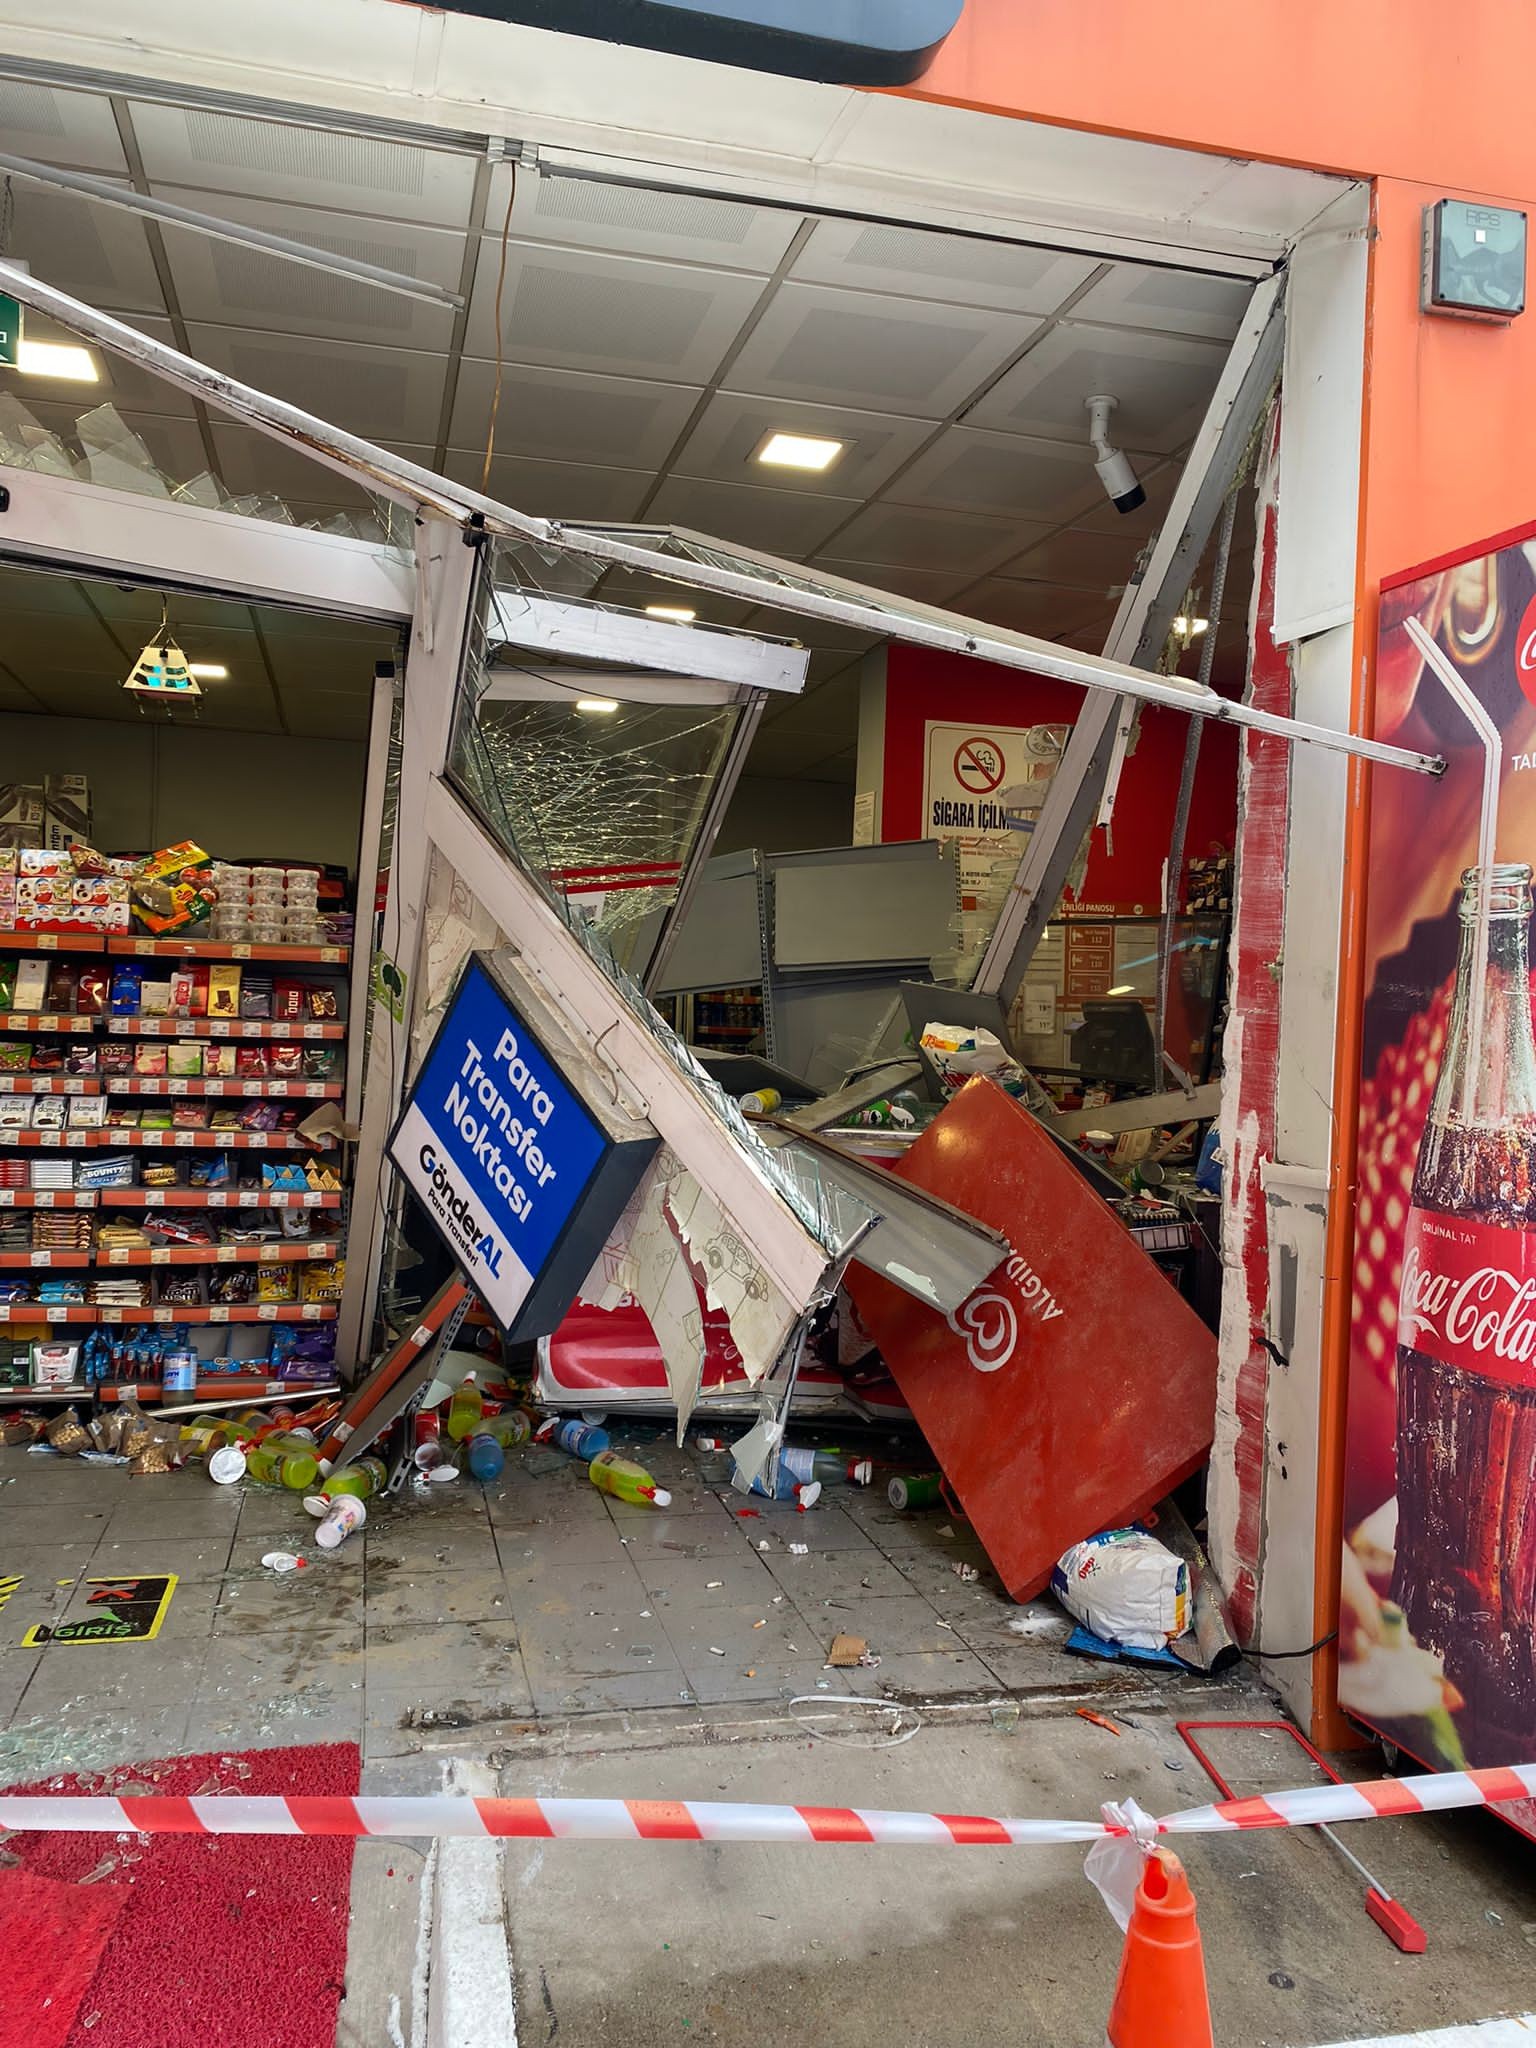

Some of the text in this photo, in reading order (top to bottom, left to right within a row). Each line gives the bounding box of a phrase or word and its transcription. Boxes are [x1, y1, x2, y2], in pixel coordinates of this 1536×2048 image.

[933, 796, 975, 828] SİGARA
[460, 1039, 557, 1187] Transfer
[493, 1027, 556, 1126] Para
[443, 1081, 535, 1224] Noktası
[418, 1143, 504, 1280] GönderAL
[427, 1188, 479, 1268] Para Transferi
[1459, 1232, 1477, 1245] TAT
